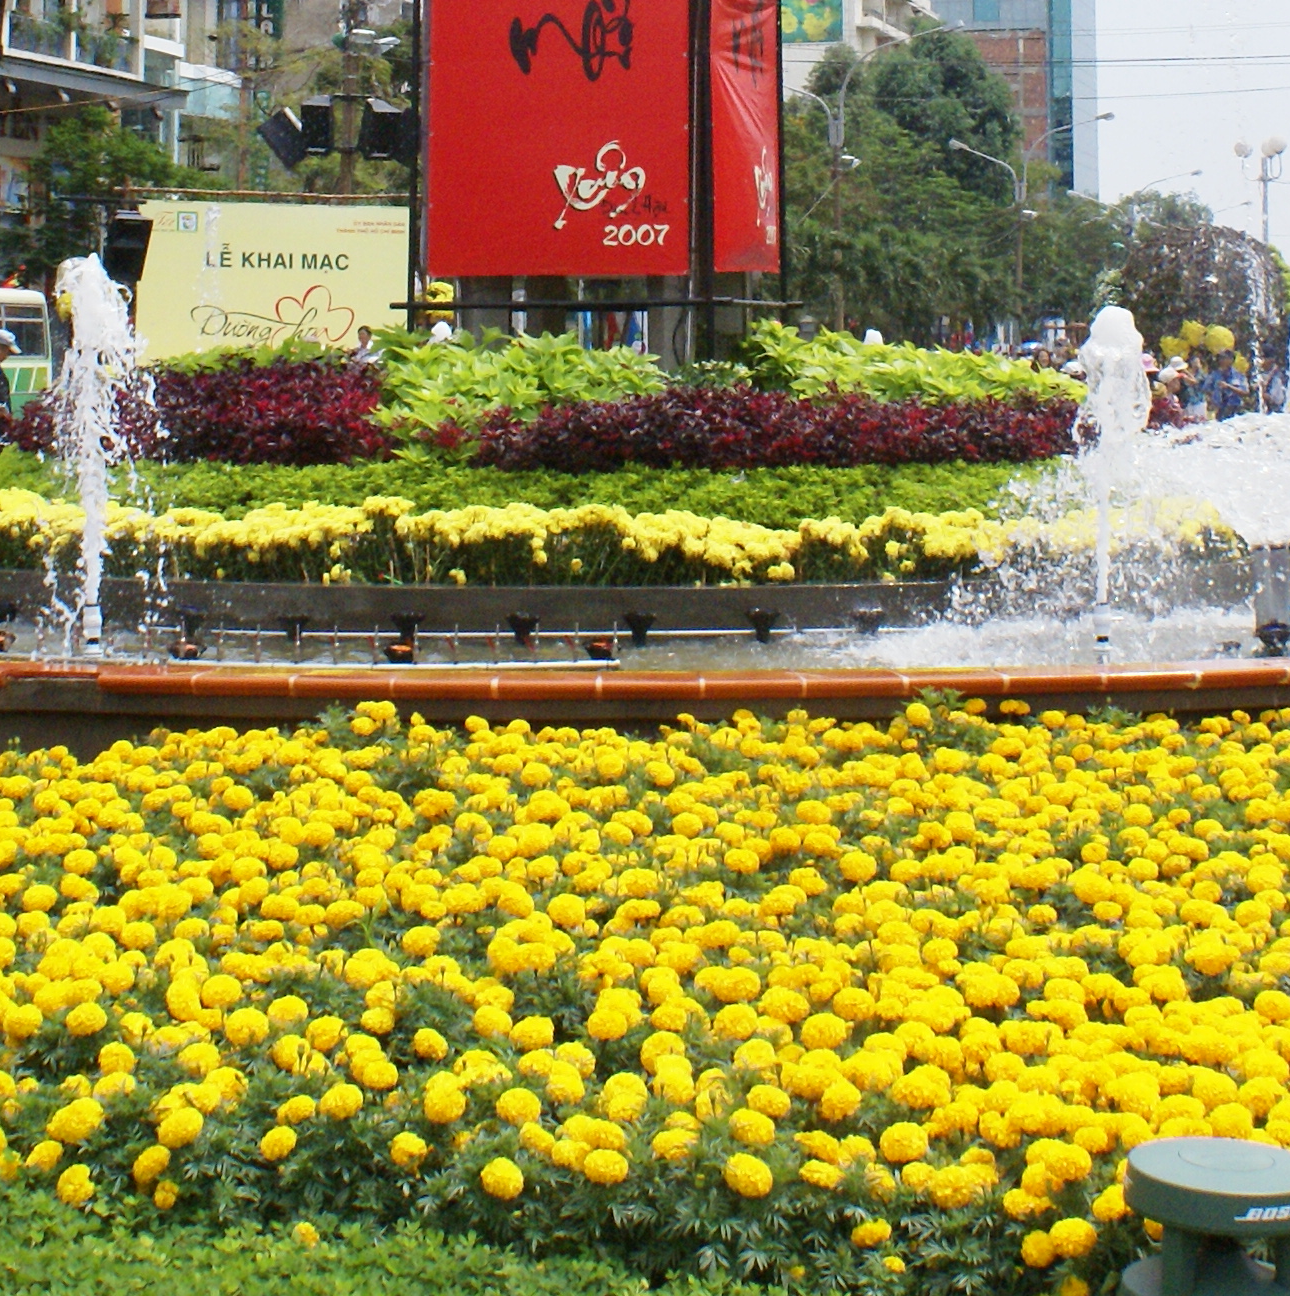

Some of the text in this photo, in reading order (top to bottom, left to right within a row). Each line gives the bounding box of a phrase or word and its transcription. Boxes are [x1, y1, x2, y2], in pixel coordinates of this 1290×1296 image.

[602, 224, 670, 246] 2007
[241, 251, 294, 271] KHAI
[301, 253, 350, 275] MẠC
